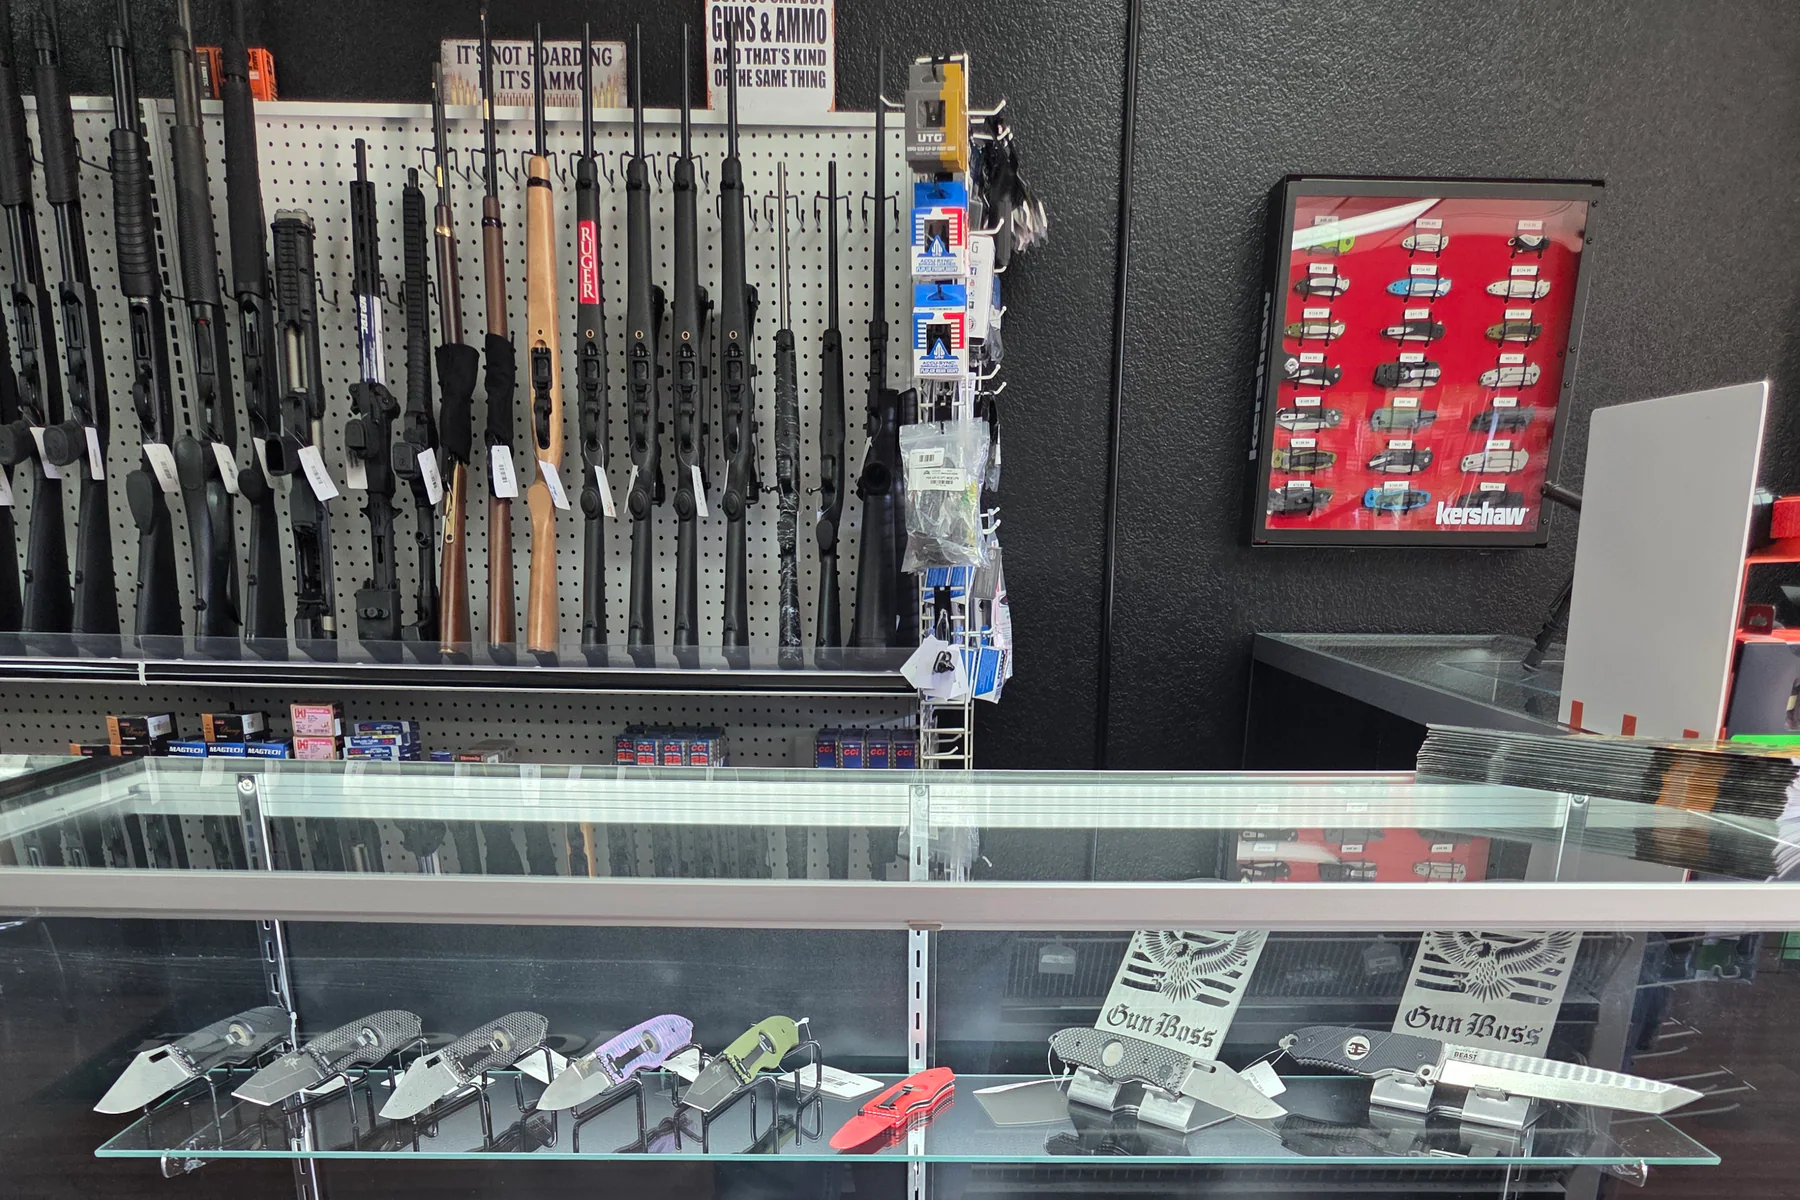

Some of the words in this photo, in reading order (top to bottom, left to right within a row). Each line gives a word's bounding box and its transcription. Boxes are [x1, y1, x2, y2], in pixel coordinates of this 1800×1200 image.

[712, 5, 756, 43] GUNS
[760, 12, 772, 43] &
[775, 7, 827, 44] AMMO
[456, 45, 482, 65] IT'S
[491, 46, 522, 65] NOT
[527, 47, 612, 67] HOARDNG
[744, 48, 790, 65] THAT'S
[793, 49, 827, 66] KIND
[500, 70, 531, 90] IT'S
[755, 69, 788, 88] SAME
[790, 70, 826, 88] THING
[917, 133, 943, 143] UTG
[580, 226, 595, 298] RUGER
[1435, 501, 1526, 525] kershaw
[169, 746, 203, 754] MAGTECH
[209, 746, 243, 754] MAGTECH
[247, 747, 281, 755] MAGTECH
[1106, 1003, 1154, 1033] Gun
[1152, 1012, 1218, 1048] Boss
[1404, 1005, 1464, 1034] Gun
[1464, 1012, 1543, 1046] Boss
[1454, 1051, 1478, 1061] BEAST
